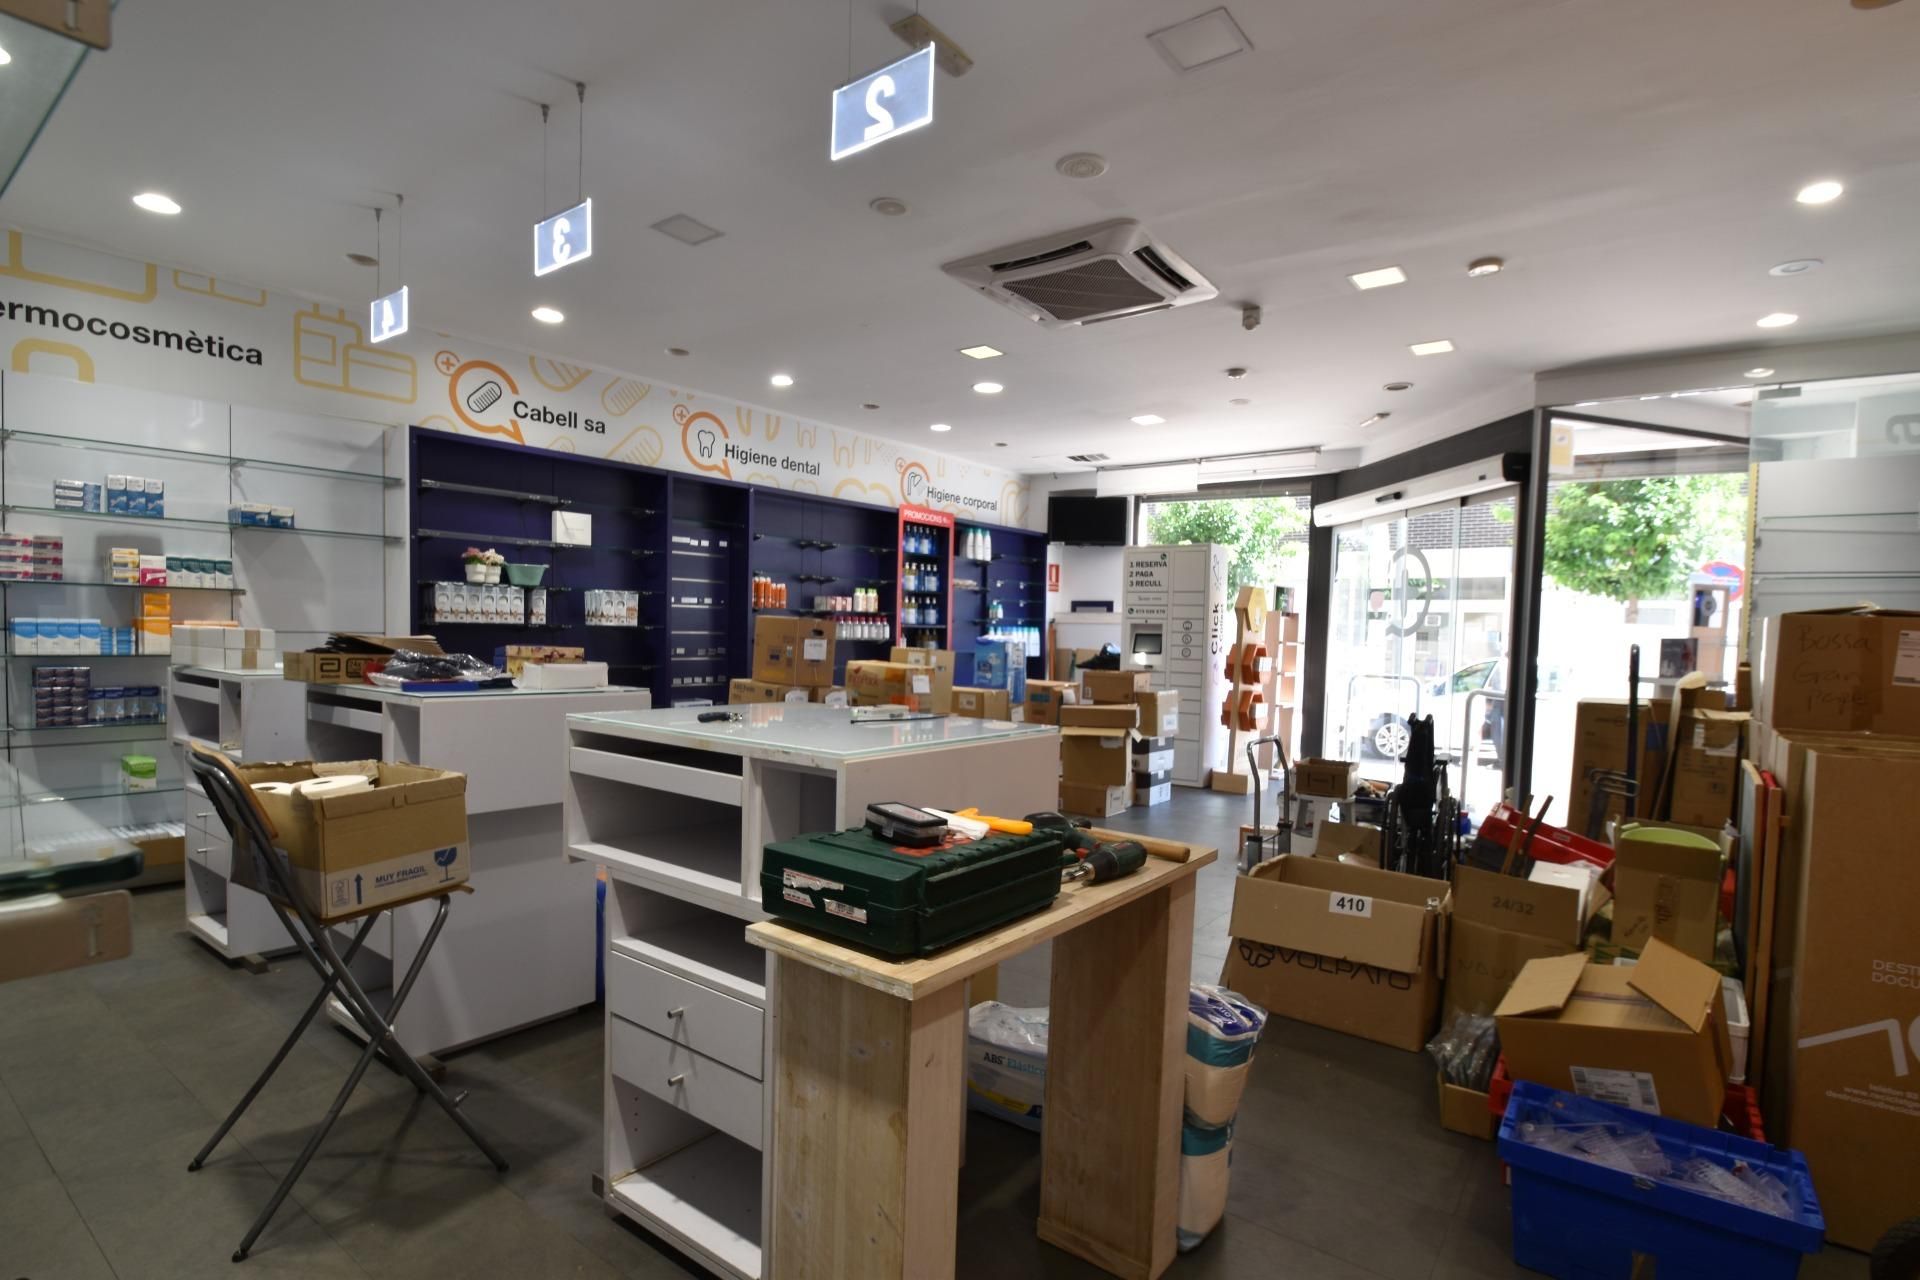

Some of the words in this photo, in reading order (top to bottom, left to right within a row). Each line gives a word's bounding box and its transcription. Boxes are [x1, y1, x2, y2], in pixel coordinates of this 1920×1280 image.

[513, 400, 578, 429] Cabell
[584, 417, 606, 434] sa
[724, 443, 777, 469] Higiene
[781, 457, 820, 477] dental
[926, 486, 961, 505] Higiene
[963, 493, 997, 512] corporal
[903, 509, 942, 524] PROMOCIONS
[1135, 560, 1168, 568] RESERVA
[1211, 602, 1220, 655] Click
[375, 872, 395, 884] MUY
[396, 865, 427, 879] FRAGIL
[1336, 896, 1366, 913] 410
[1491, 896, 1536, 915] 24/32
[983, 1052, 1004, 1065] ABS
